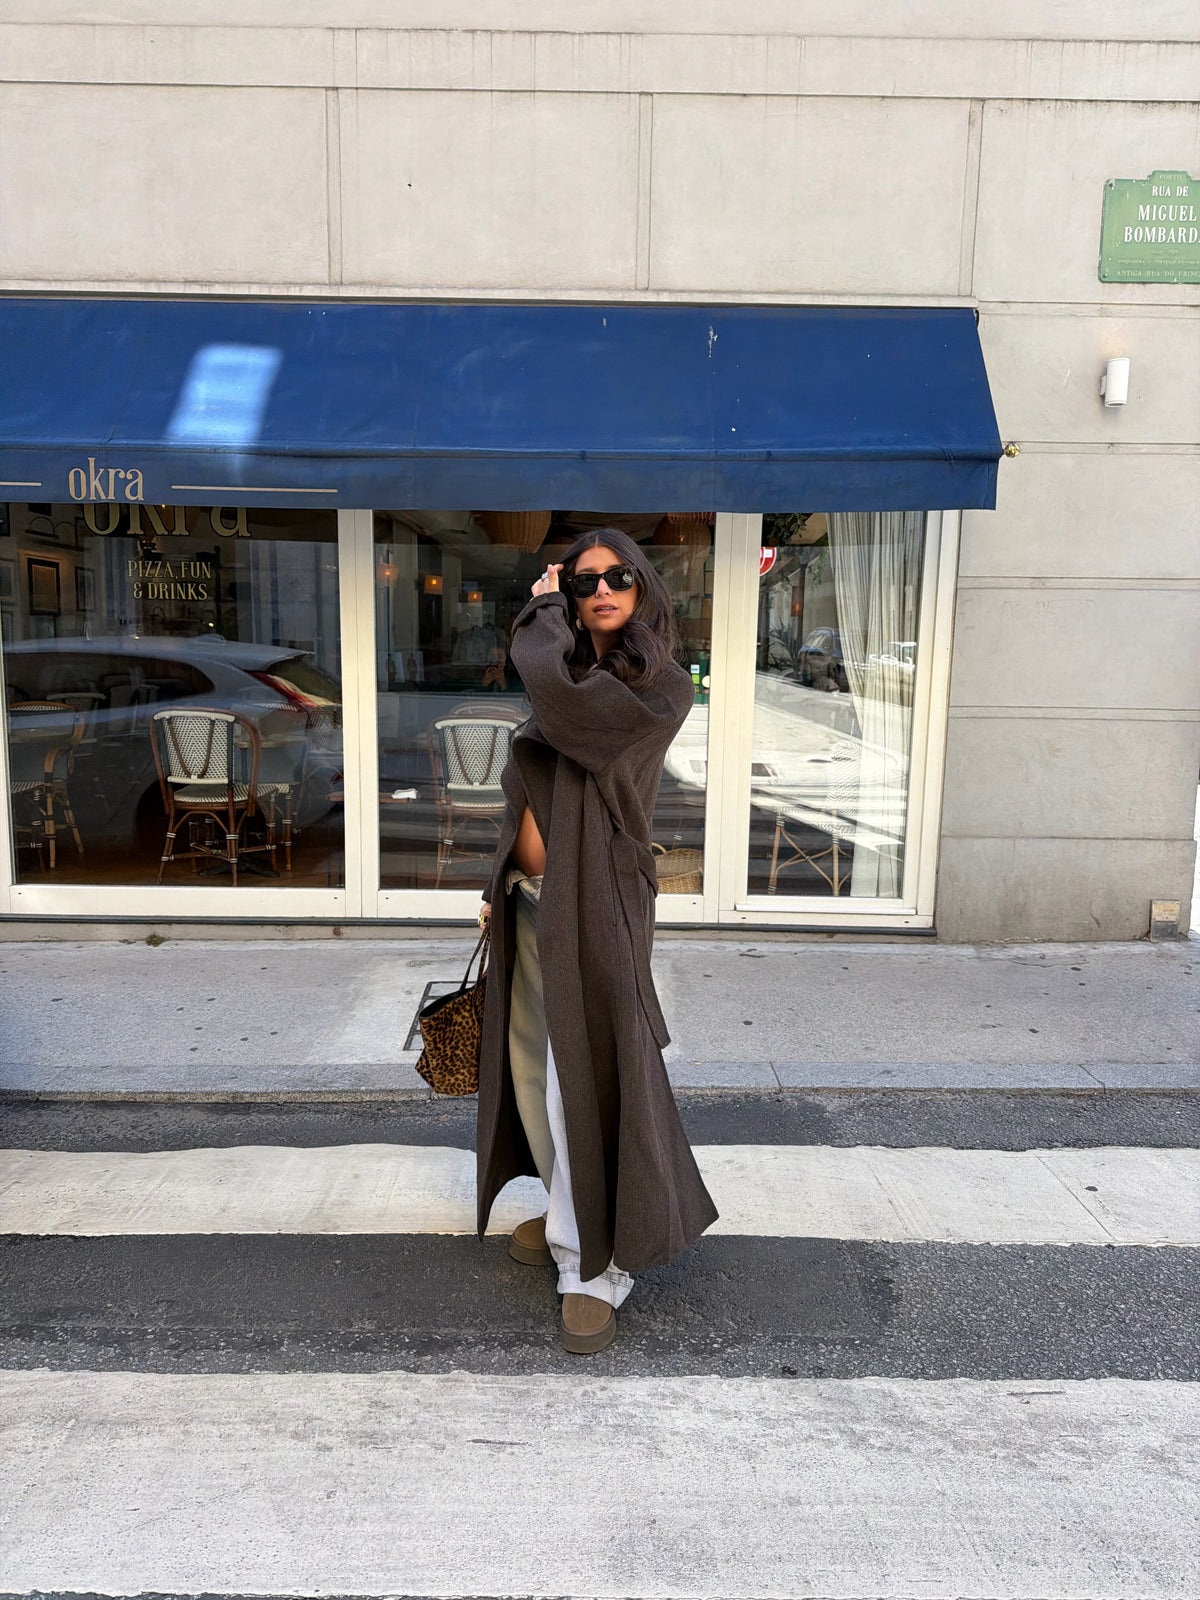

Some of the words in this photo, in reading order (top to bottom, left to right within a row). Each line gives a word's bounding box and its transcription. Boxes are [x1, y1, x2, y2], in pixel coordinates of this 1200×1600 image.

[1152, 185, 1171, 197] RUA
[1176, 186, 1189, 197] DE
[1138, 205, 1197, 222] MIGUEL
[1124, 226, 1200, 244] BOMBARD
[68, 457, 145, 501] okra
[127, 560, 178, 580] PIZZA,
[181, 561, 212, 579] FUN
[133, 582, 143, 599] &
[148, 582, 208, 601] DRINKS
